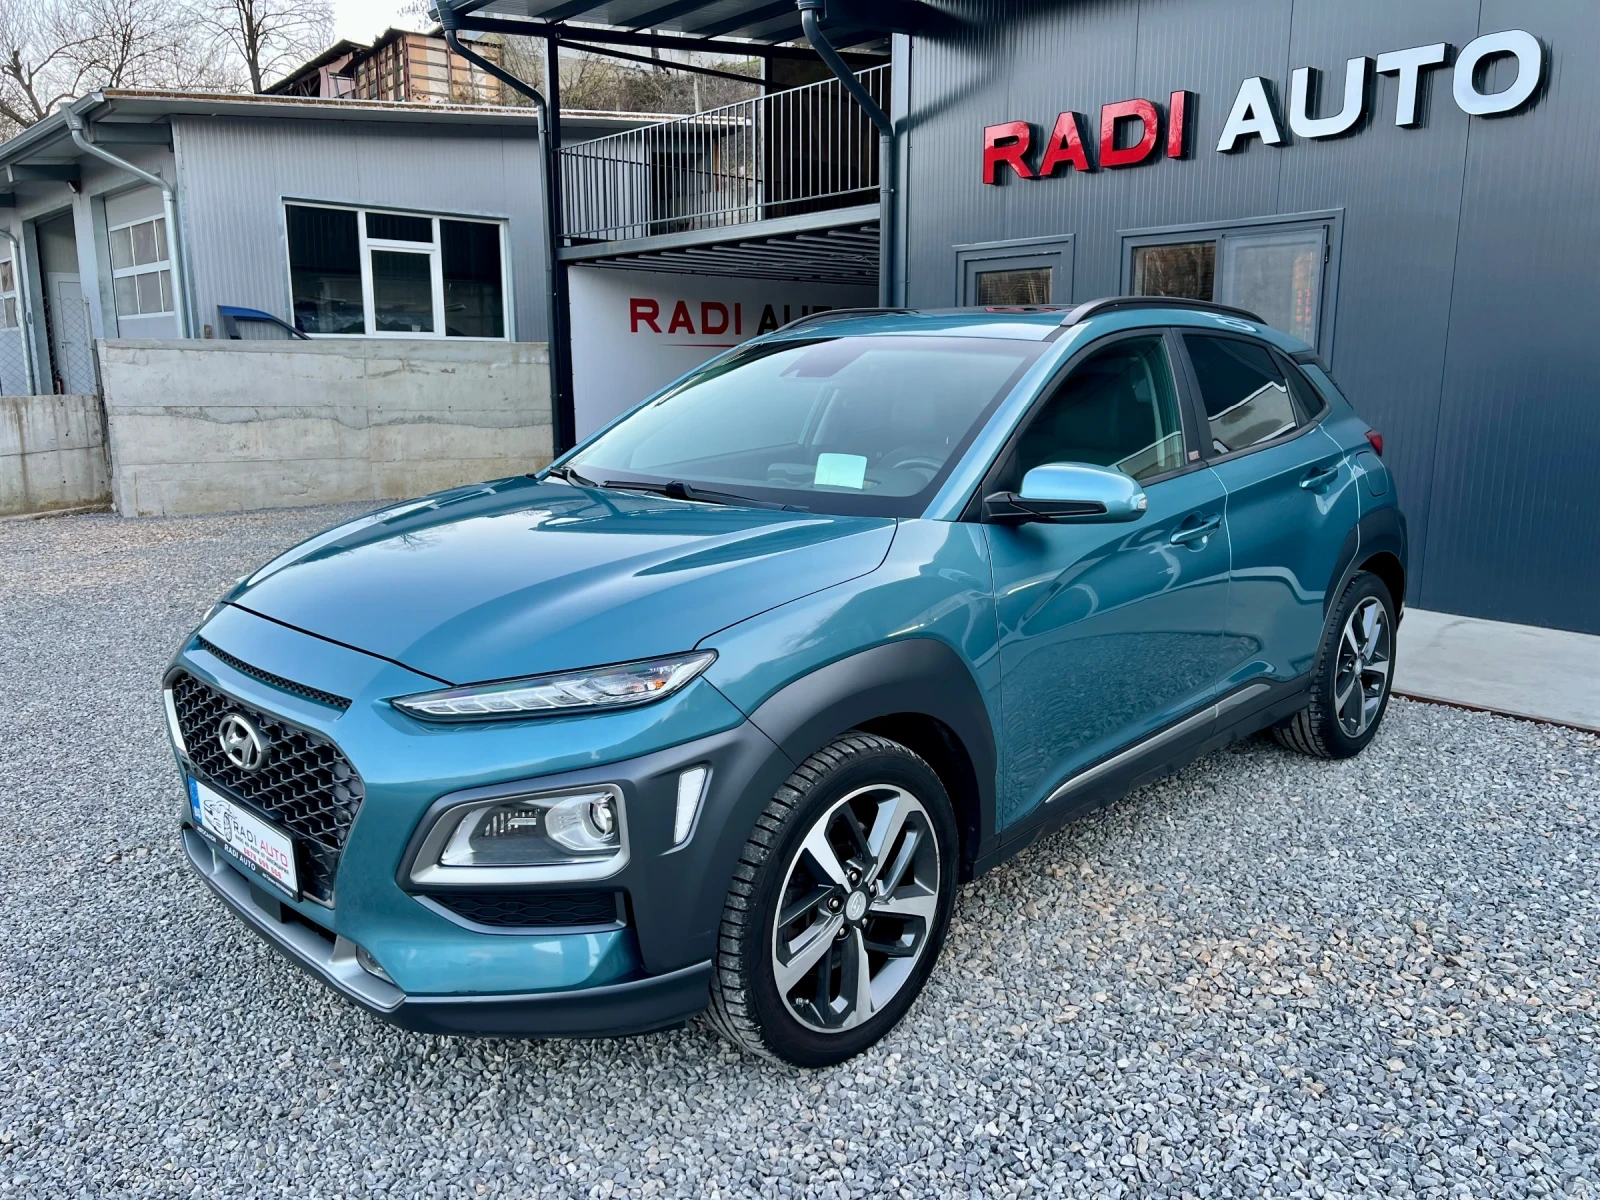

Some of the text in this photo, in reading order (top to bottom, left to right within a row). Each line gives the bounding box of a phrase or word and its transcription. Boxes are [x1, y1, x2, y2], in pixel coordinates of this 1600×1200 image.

[983, 29, 1546, 185] RADI AUTO
[629, 297, 742, 335] RADI
[224, 843, 239, 859] RADI
[239, 854, 256, 871] AUTO
[233, 820, 257, 847] RADI
[260, 839, 288, 868] AUTO
